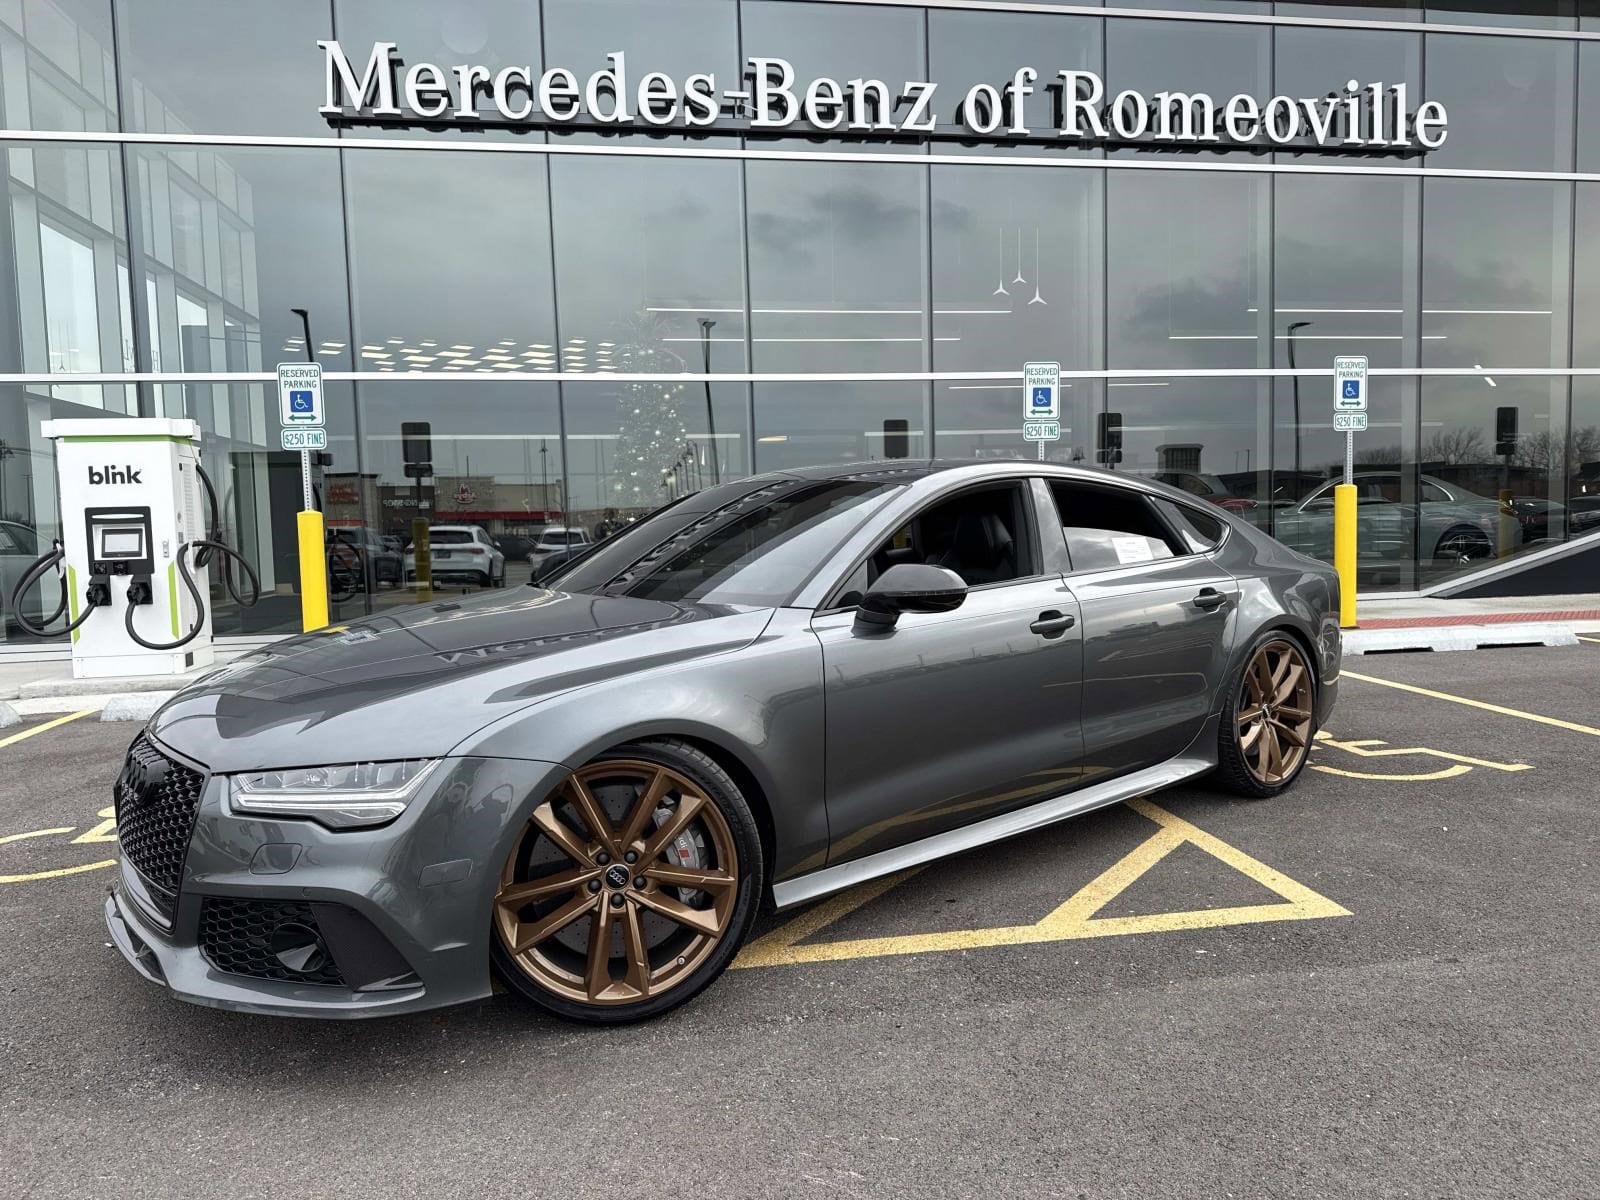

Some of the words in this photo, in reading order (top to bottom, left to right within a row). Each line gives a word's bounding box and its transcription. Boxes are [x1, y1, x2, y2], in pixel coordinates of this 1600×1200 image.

[316, 40, 938, 131] Mercedes-Benz
[963, 67, 1037, 134] of
[1058, 69, 1448, 147] Romeoville
[1337, 361, 1365, 369] RESERVED
[280, 369, 319, 378] RESERVED
[1026, 367, 1058, 376] RESERVED
[1338, 370, 1364, 378] PARKING
[283, 380, 317, 389] PARKING
[1028, 377, 1056, 386] PARKING
[1336, 416, 1351, 427] $250
[1352, 416, 1366, 427] FINE
[1026, 425, 1042, 437] $250
[1044, 425, 1057, 437] FINE
[284, 433, 305, 445] $250
[306, 432, 324, 445] FINE
[88, 465, 142, 485] blink
